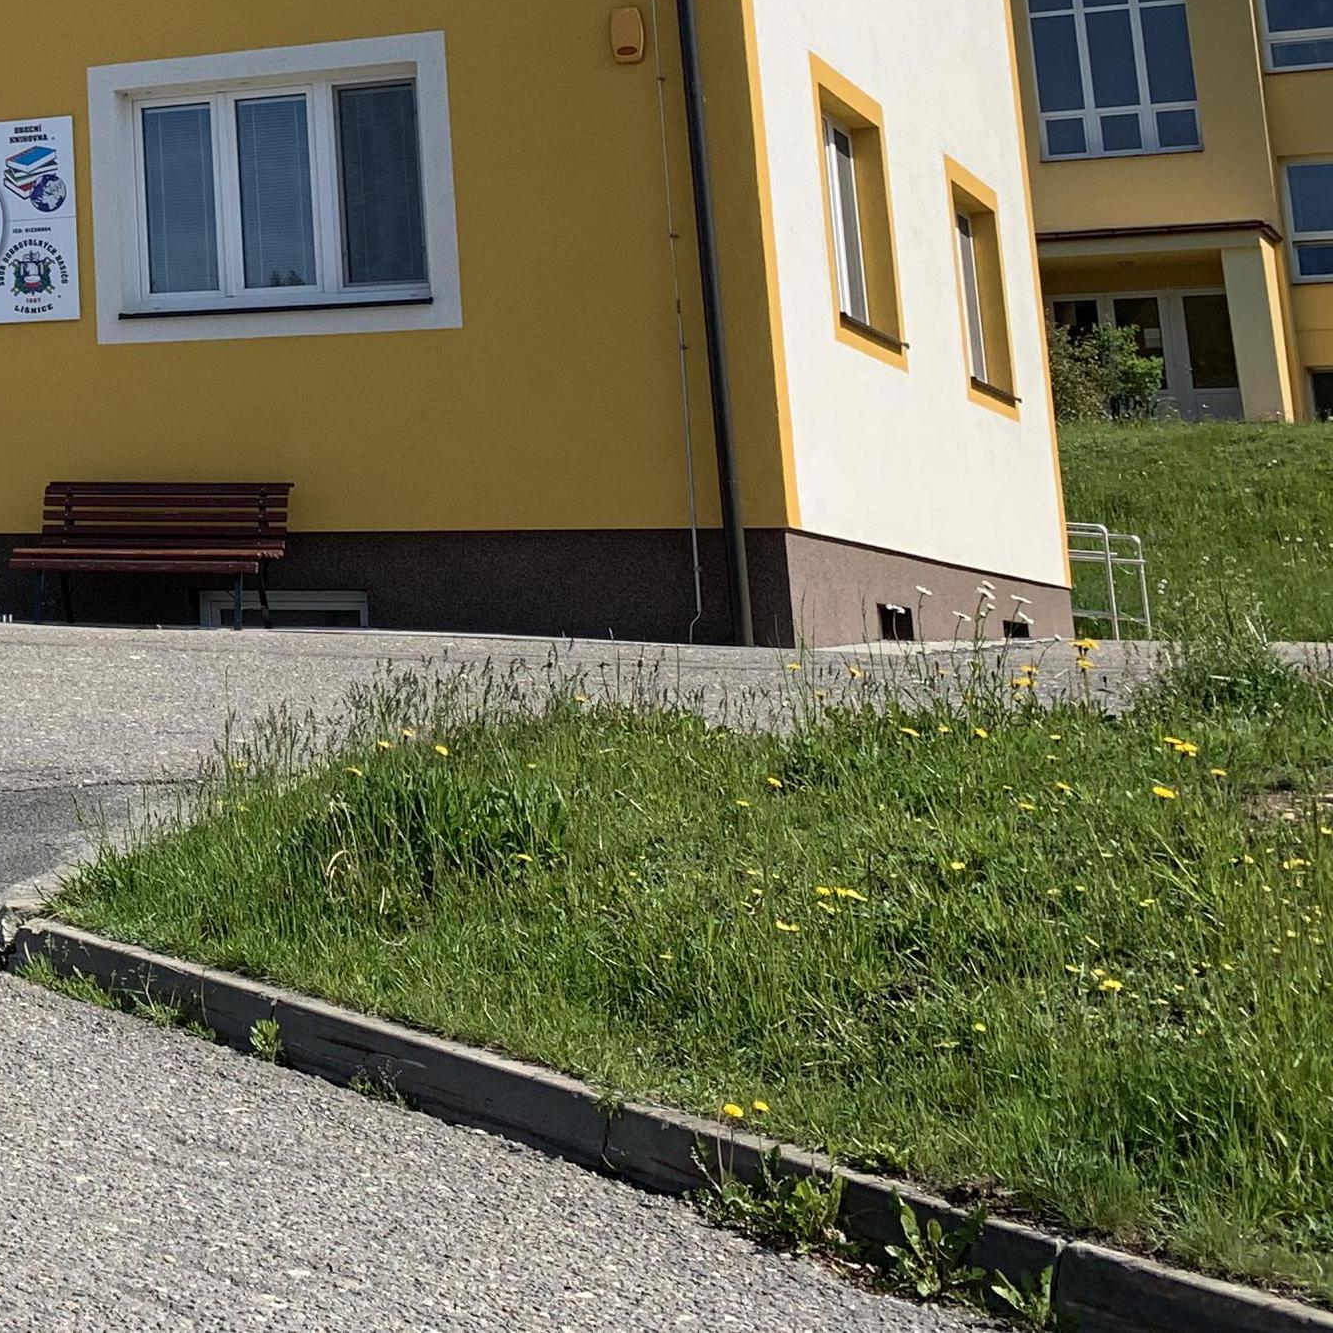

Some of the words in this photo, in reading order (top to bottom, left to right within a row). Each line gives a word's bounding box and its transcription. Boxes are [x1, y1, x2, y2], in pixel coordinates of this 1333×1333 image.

[14, 125, 42, 134] OBECNÍ
[9, 134, 48, 144] KNIHOVNA
[14, 303, 53, 313] LIŠNICE
